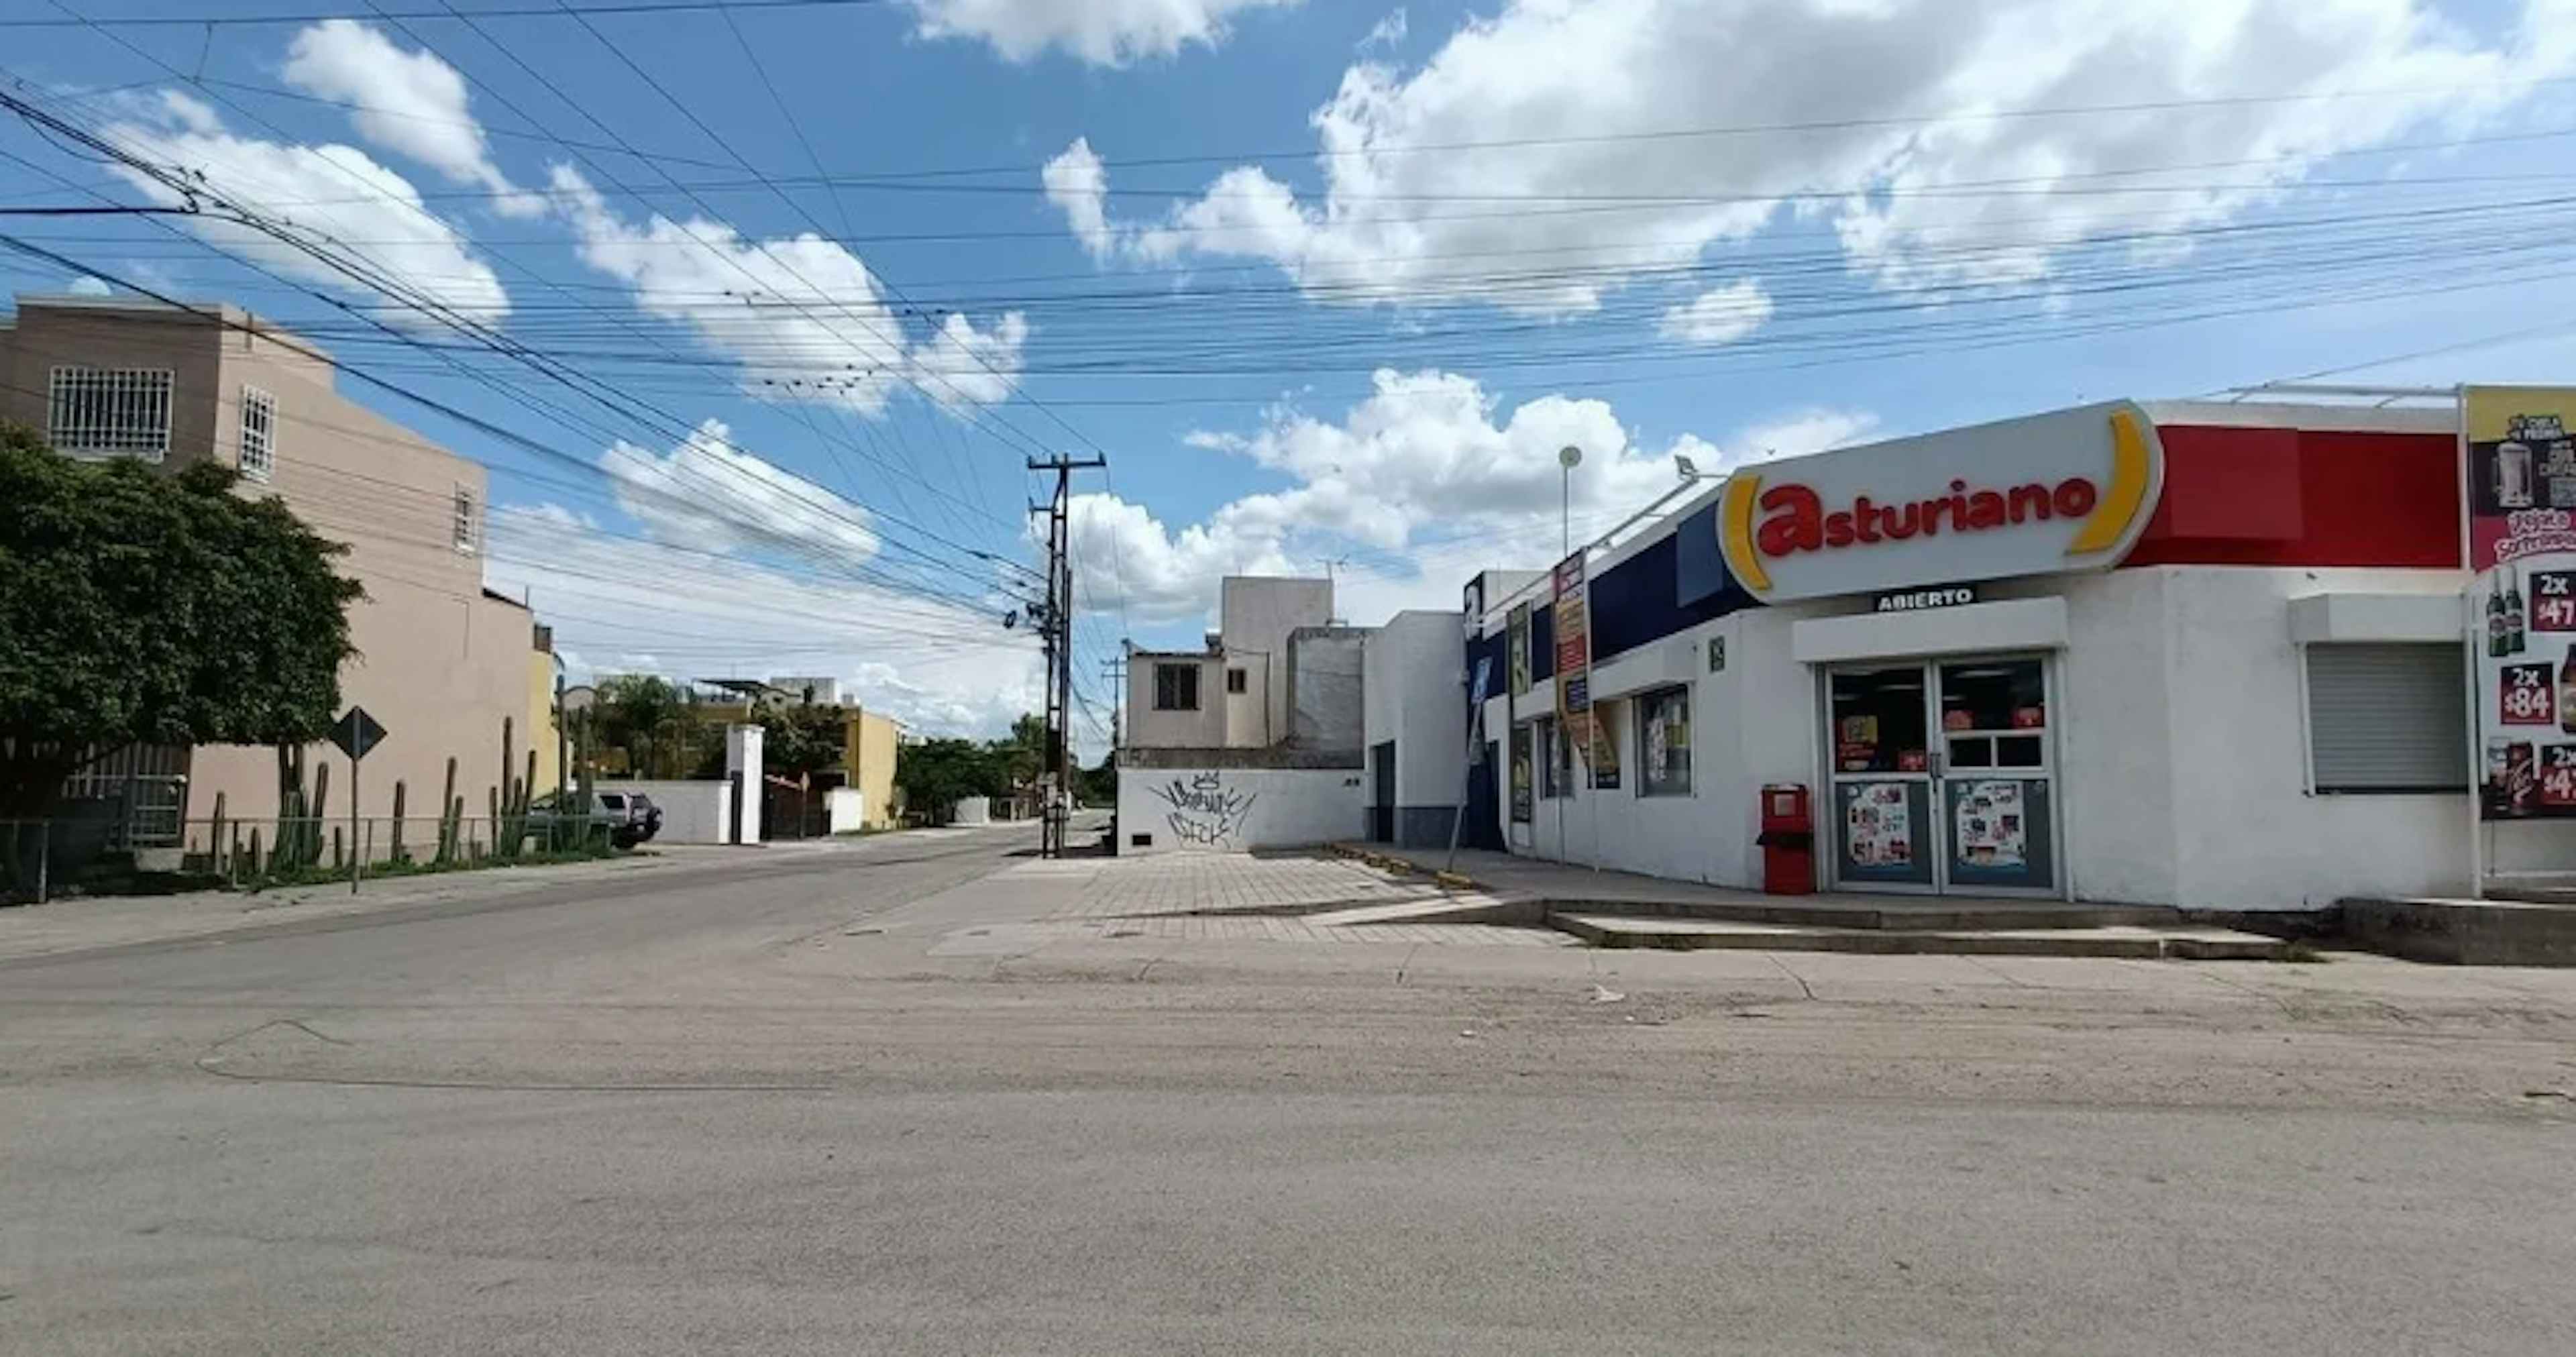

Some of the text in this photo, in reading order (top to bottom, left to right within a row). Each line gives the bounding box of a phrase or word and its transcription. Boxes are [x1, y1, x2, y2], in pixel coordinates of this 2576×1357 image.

[1758, 477, 2096, 557] asturiano
[2540, 575, 2569, 595] 2x
[1878, 588, 1974, 612] ABIERTO
[2538, 598, 2575, 625] $47
[2513, 667, 2539, 687] 2x
[2504, 686, 2550, 718] $84
[2543, 769, 2576, 800] $4
